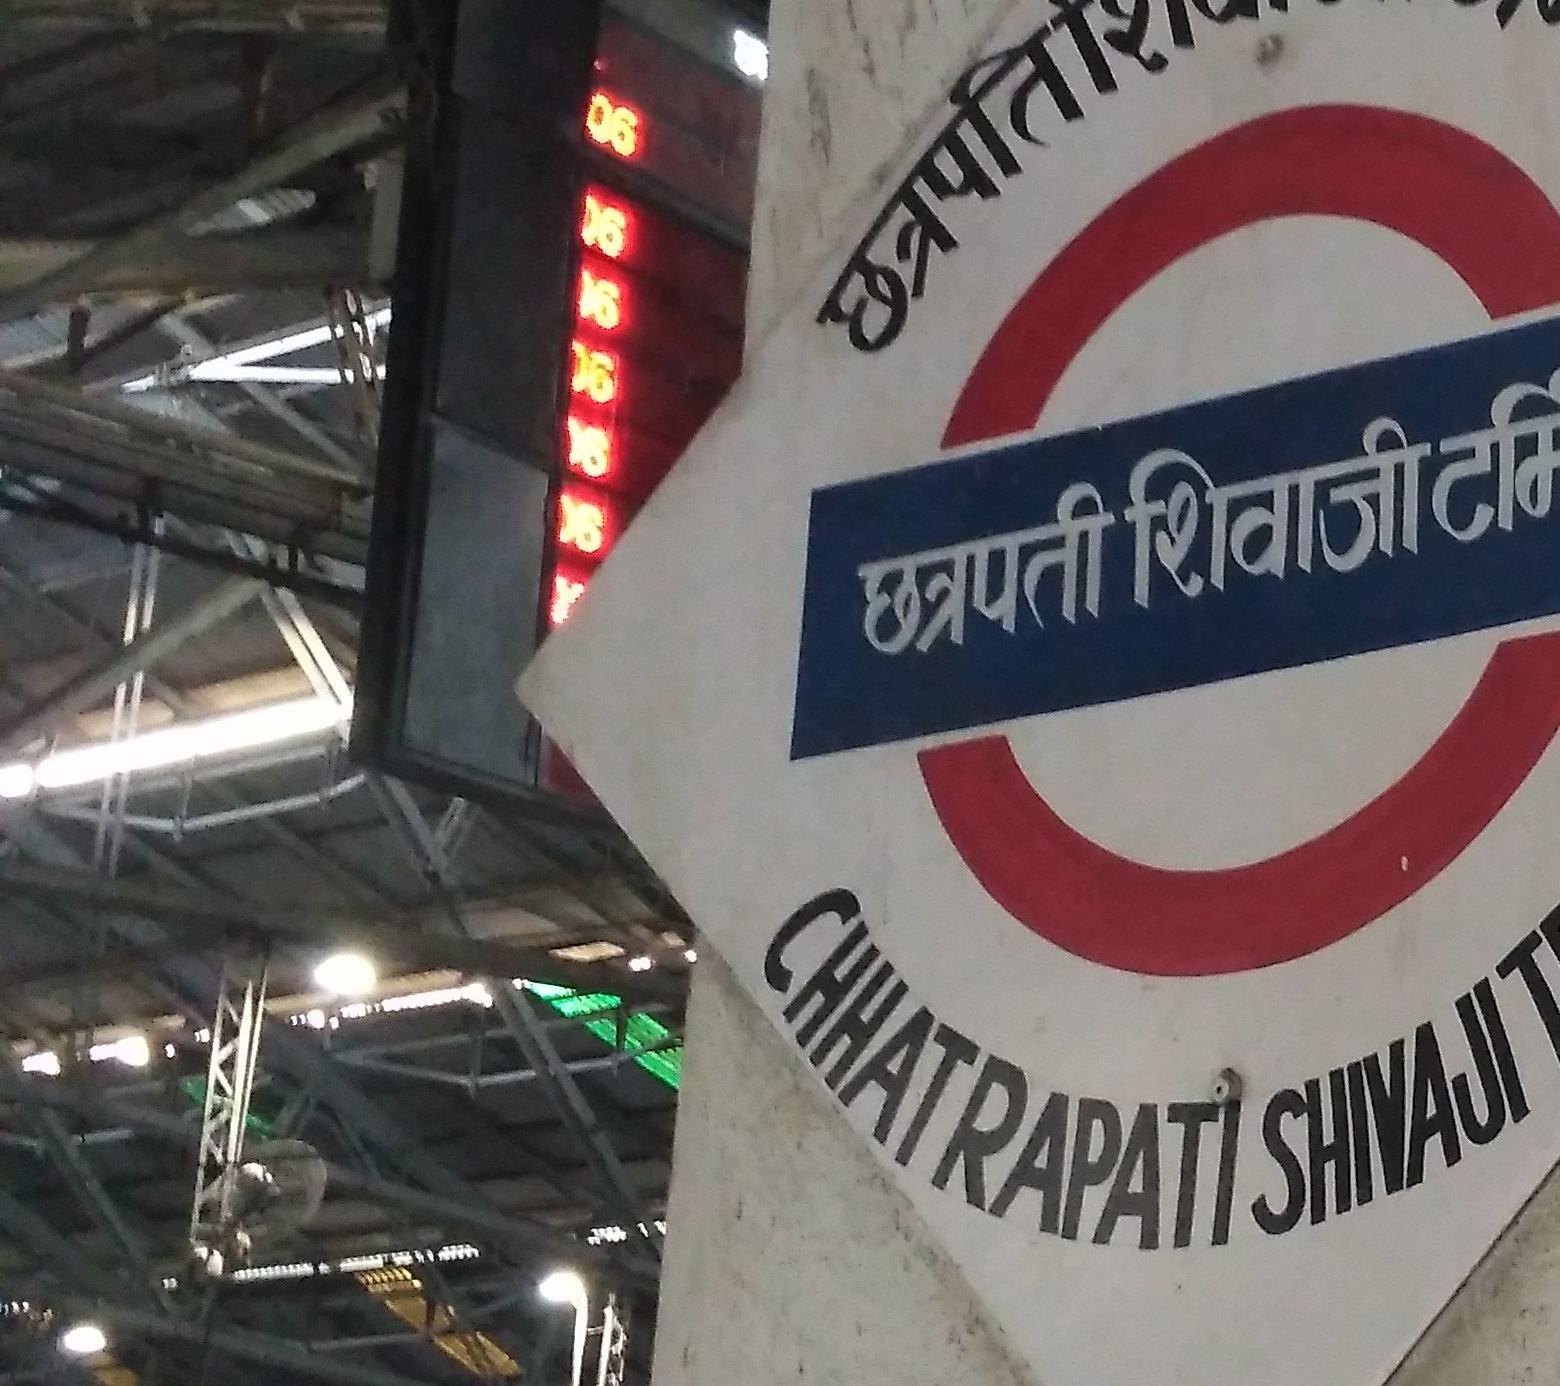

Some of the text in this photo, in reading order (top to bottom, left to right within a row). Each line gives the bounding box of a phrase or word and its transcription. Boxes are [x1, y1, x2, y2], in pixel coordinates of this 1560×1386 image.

[816, 23, 1085, 352] छत्रपति
[858, 481, 1115, 654] छत्रपती
[1124, 416, 1432, 608] शिवाजी
[764, 887, 1242, 1250] CHHATRAPATI
[1251, 976, 1531, 1235] SHIVAJI
